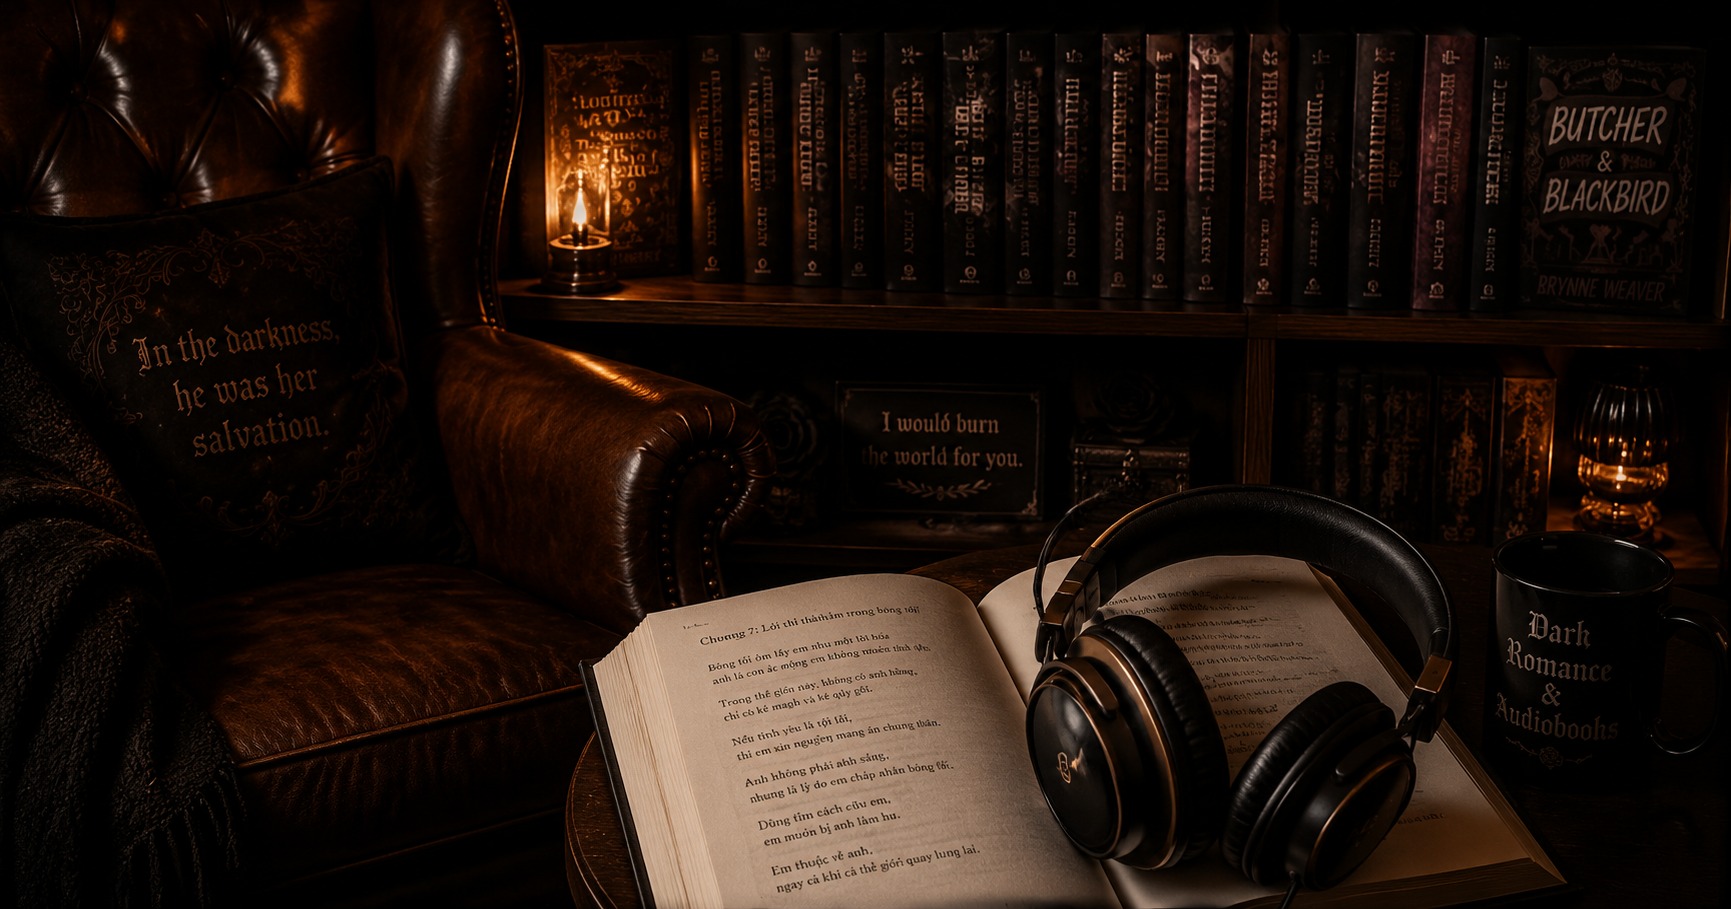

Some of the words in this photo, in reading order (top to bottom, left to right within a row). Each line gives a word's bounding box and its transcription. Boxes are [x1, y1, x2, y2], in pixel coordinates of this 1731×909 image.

[1548, 105, 1668, 146] BUTCHER
[1596, 150, 1614, 173] &
[1542, 177, 1671, 216] BLACKBIRD
[1536, 274, 1600, 299] BRYNNE
[1603, 278, 1666, 302] WEAVER
[131, 336, 173, 377] In
[177, 328, 220, 366] the
[223, 317, 341, 356] darkness,
[172, 378, 207, 417] he
[213, 374, 271, 405] was
[275, 362, 319, 400] her
[192, 411, 331, 458] salvation.
[881, 411, 892, 433] I
[896, 411, 950, 434] would
[956, 412, 1001, 435] burn
[861, 443, 888, 469] the
[894, 445, 948, 467] world
[953, 445, 982, 467] for
[985, 451, 1024, 471] you.
[747, 627, 759, 635] 7:
[1527, 610, 1591, 650] Dark
[1506, 637, 1614, 683] Romance
[712, 674, 732, 685] anh
[746, 667, 765, 678] con
[718, 695, 752, 707] Trong
[1541, 682, 1562, 707] &
[835, 729, 866, 739] mang
[882, 722, 916, 731] chung
[745, 775, 769, 788] Anh
[763, 836, 782, 847] em
[833, 819, 855, 831] anh
[771, 865, 792, 876] Em
[847, 846, 873, 858] anh.
[776, 879, 804, 893] ngay
[905, 853, 933, 867] quay
